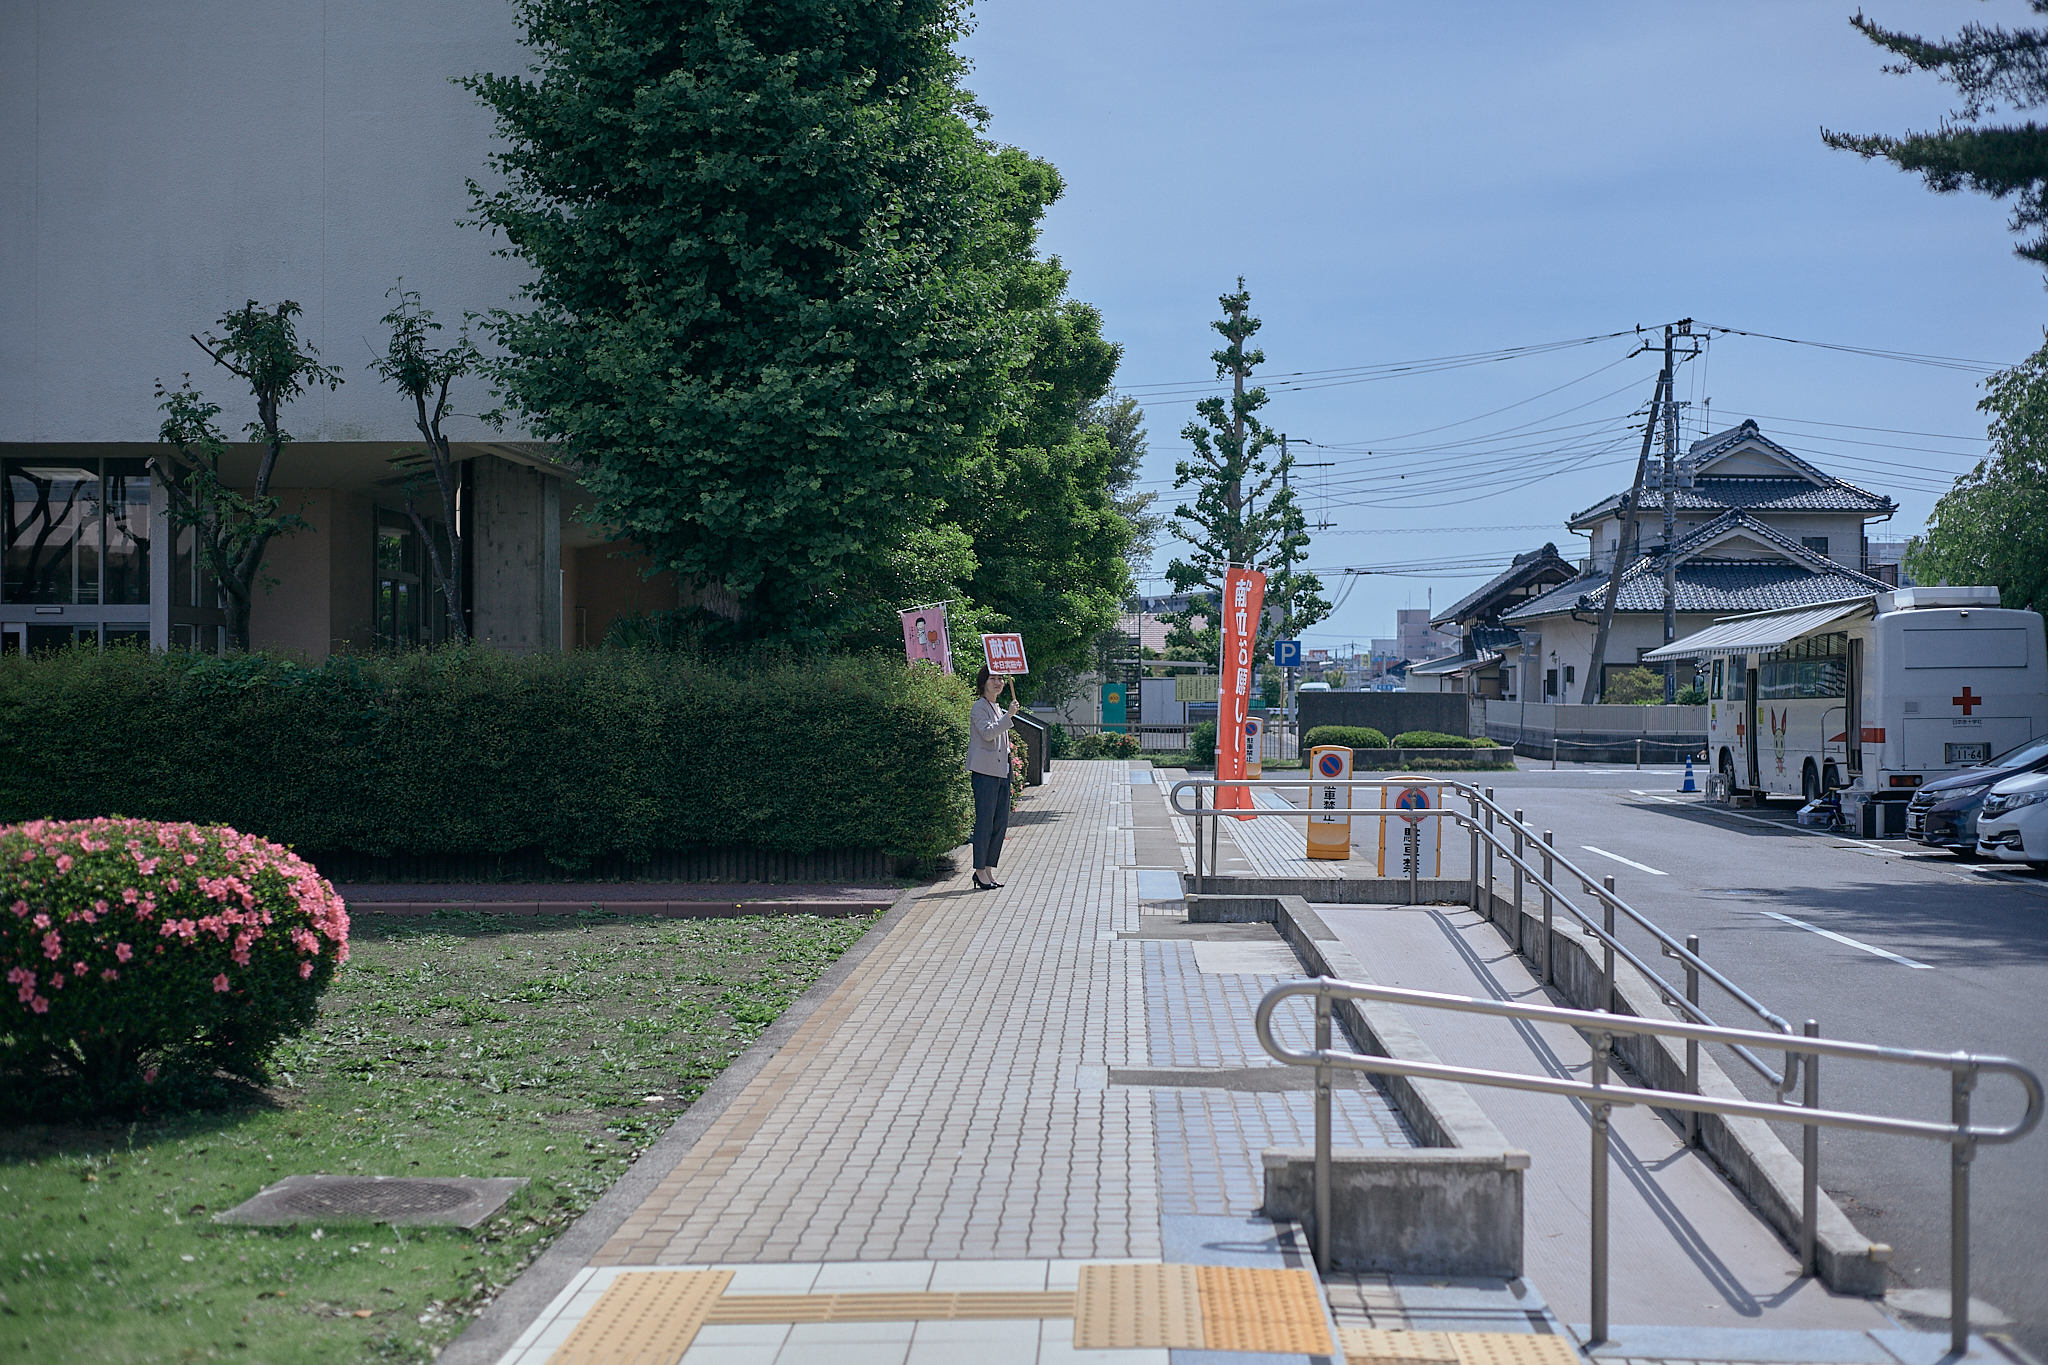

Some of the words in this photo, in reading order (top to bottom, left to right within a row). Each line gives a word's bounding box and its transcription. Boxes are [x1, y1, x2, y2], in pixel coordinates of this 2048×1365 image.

[989, 638, 1020, 658] 献血
[1282, 643, 1296, 664] P
[1958, 750, 1981, 759] 11-64
